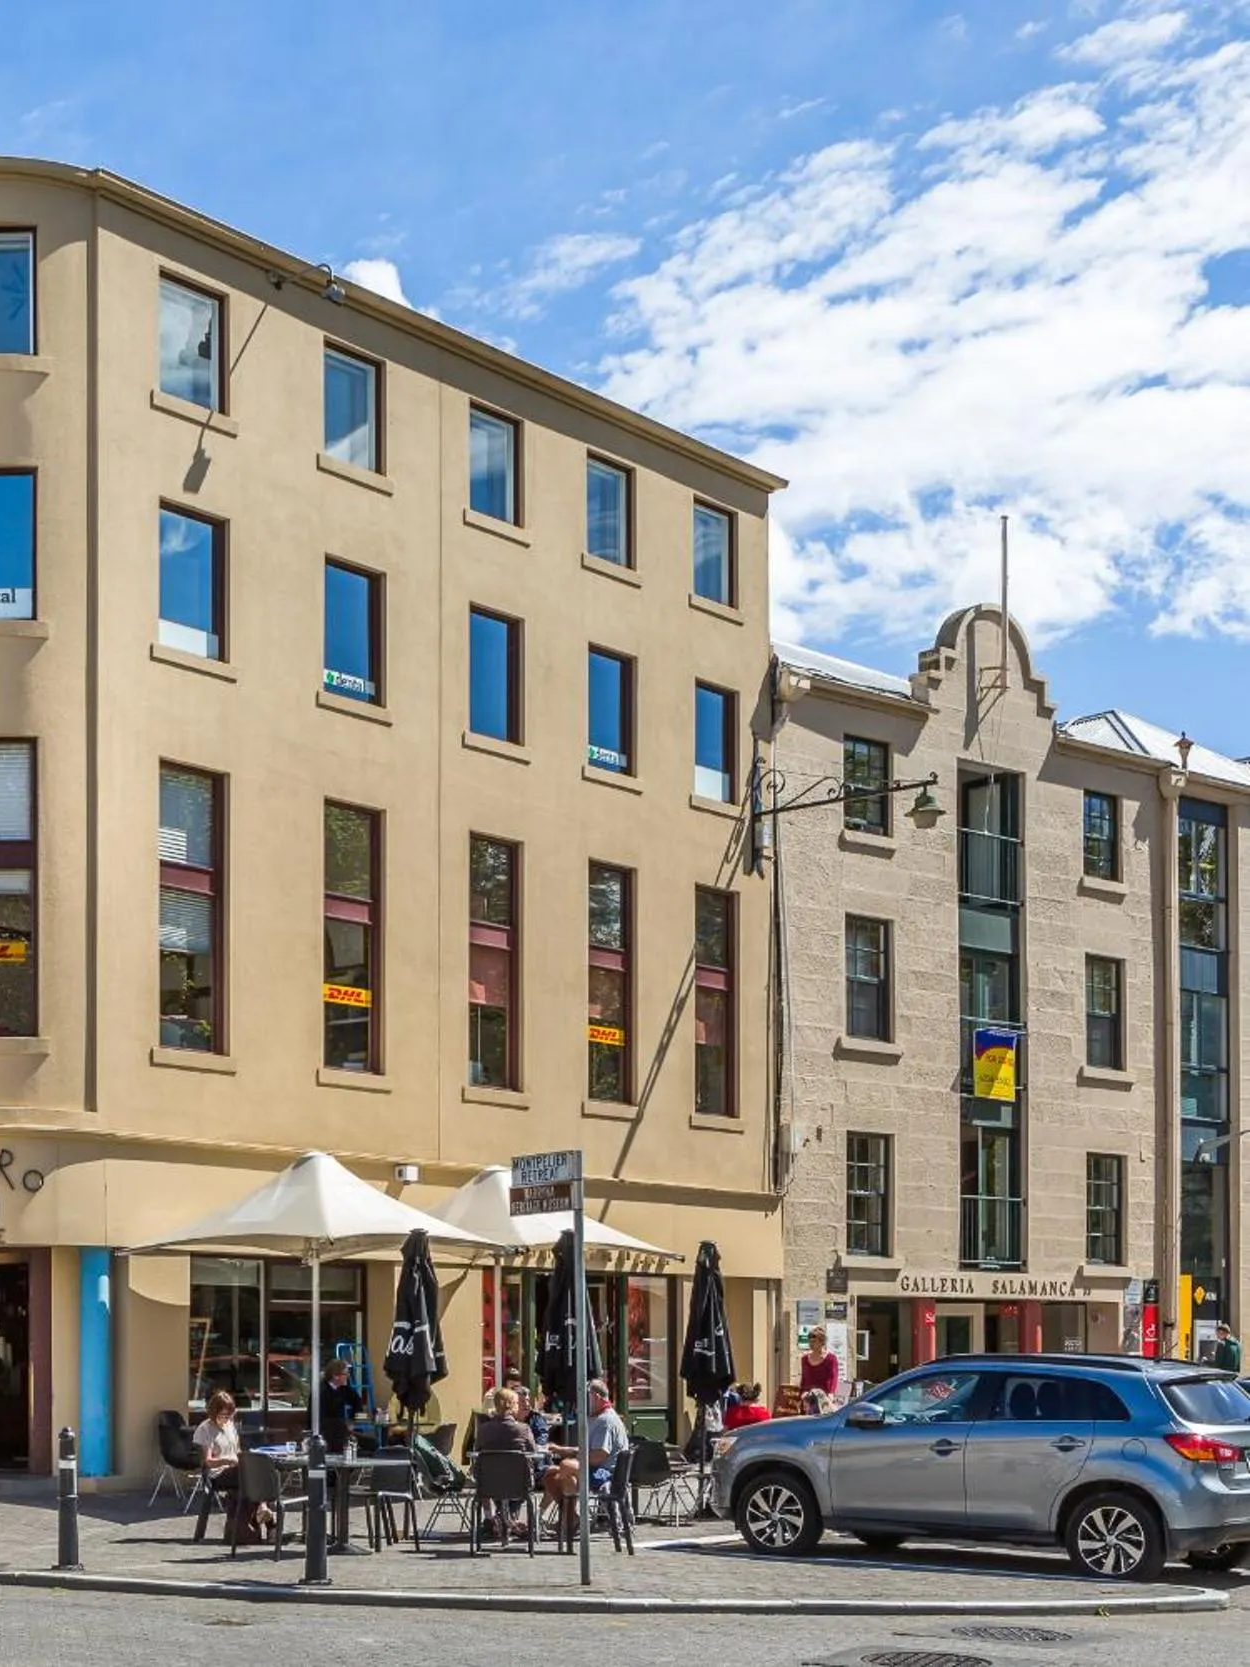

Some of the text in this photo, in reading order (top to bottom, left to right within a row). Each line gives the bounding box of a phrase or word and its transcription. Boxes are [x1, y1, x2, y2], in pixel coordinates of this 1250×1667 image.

[328, 987, 364, 1003] DHL
[589, 1027, 618, 1041] DHL
[512, 1153, 567, 1170] MONTPELIER
[901, 1276, 974, 1293] GALLERIA
[992, 1280, 1076, 1297] SALAMANCA
